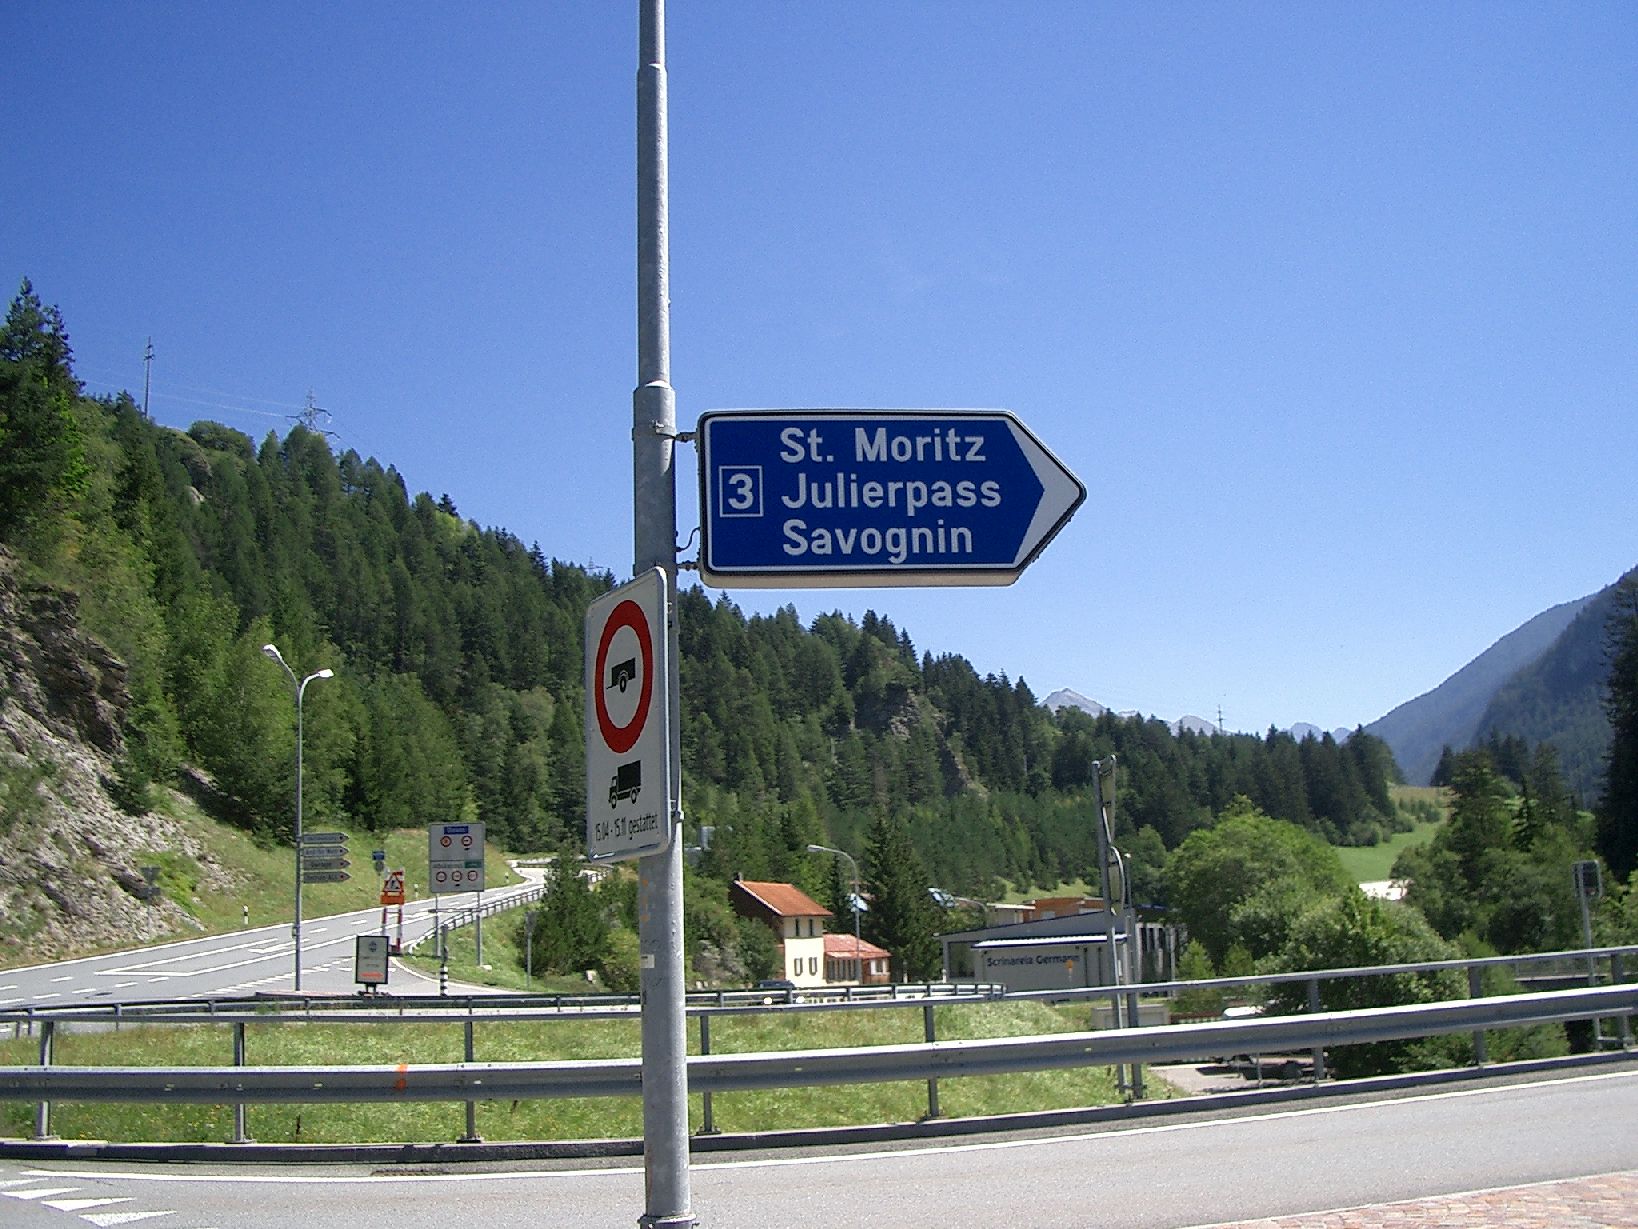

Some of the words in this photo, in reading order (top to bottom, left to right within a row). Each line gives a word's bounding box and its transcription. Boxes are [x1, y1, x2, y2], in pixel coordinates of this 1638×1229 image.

[780, 427, 834, 462] St.
[855, 427, 986, 462] Moritz
[728, 473, 754, 510] 3
[781, 472, 1001, 516] Julierpass
[783, 519, 974, 564] Savognin
